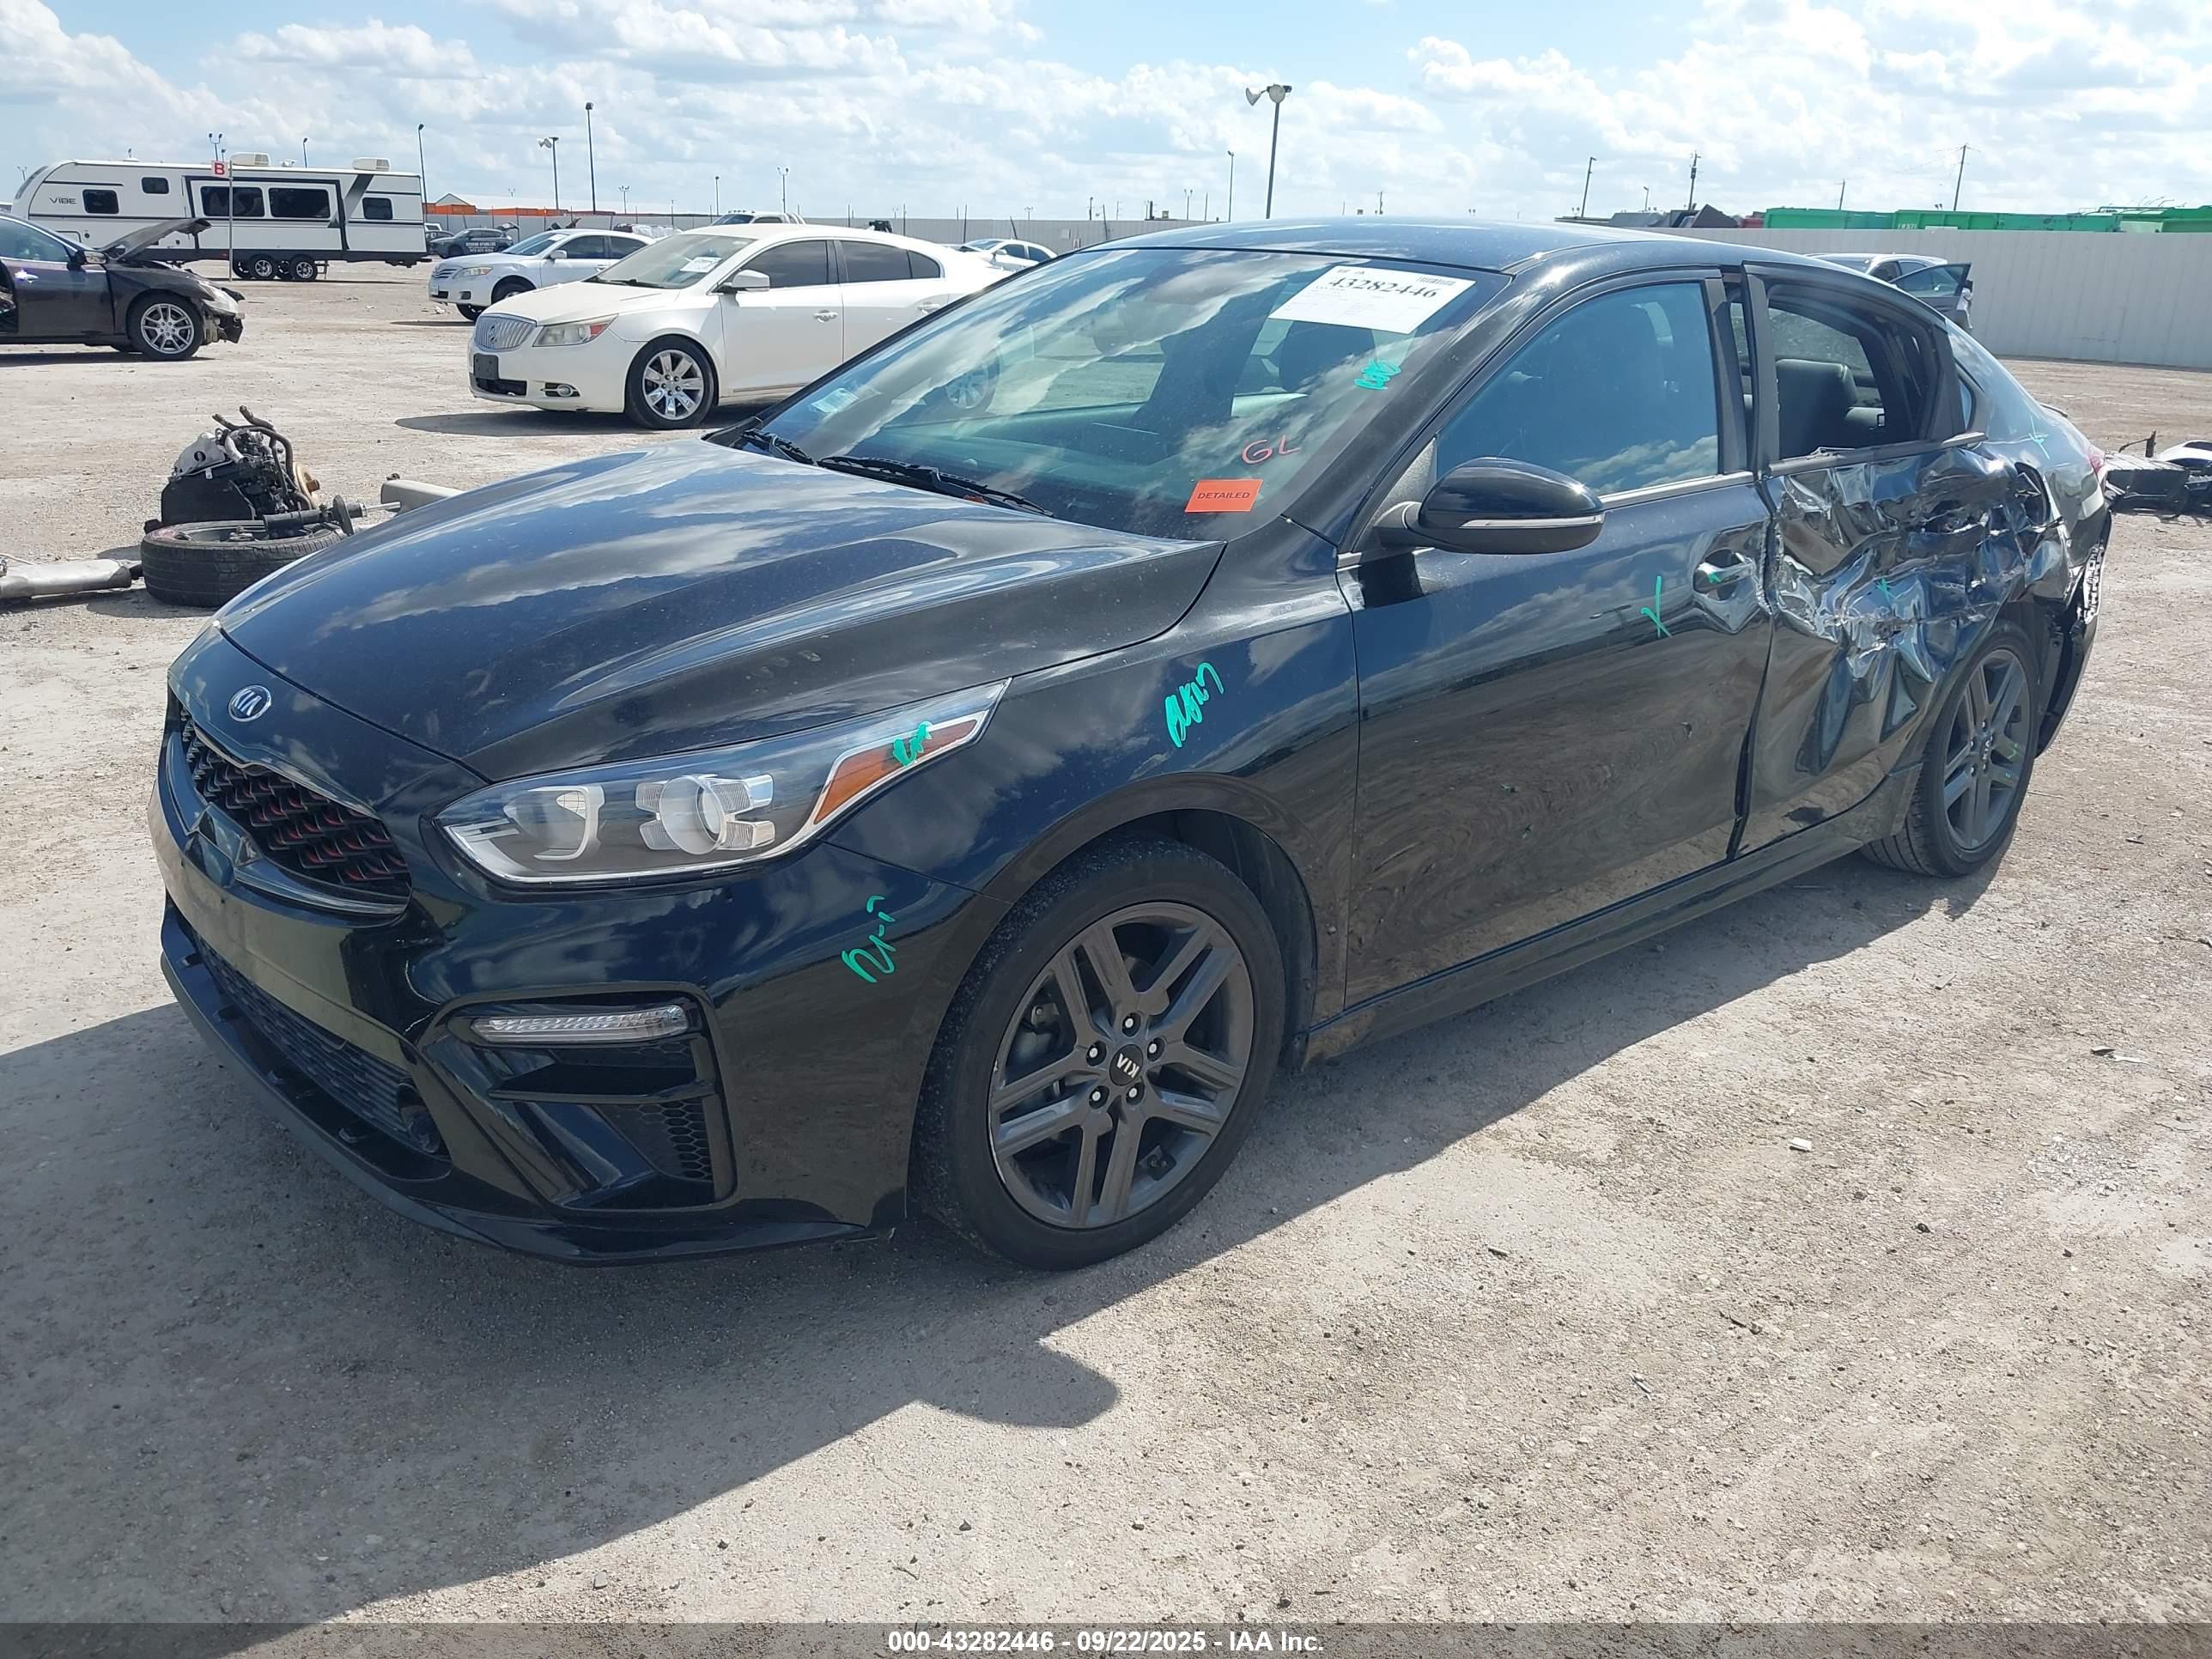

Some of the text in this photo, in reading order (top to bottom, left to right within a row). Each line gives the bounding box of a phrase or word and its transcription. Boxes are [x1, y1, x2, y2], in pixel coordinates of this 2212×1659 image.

[215, 162, 225, 175] B
[1329, 276, 1438, 299] 43282446
[1116, 1053, 1140, 1079] KIA
